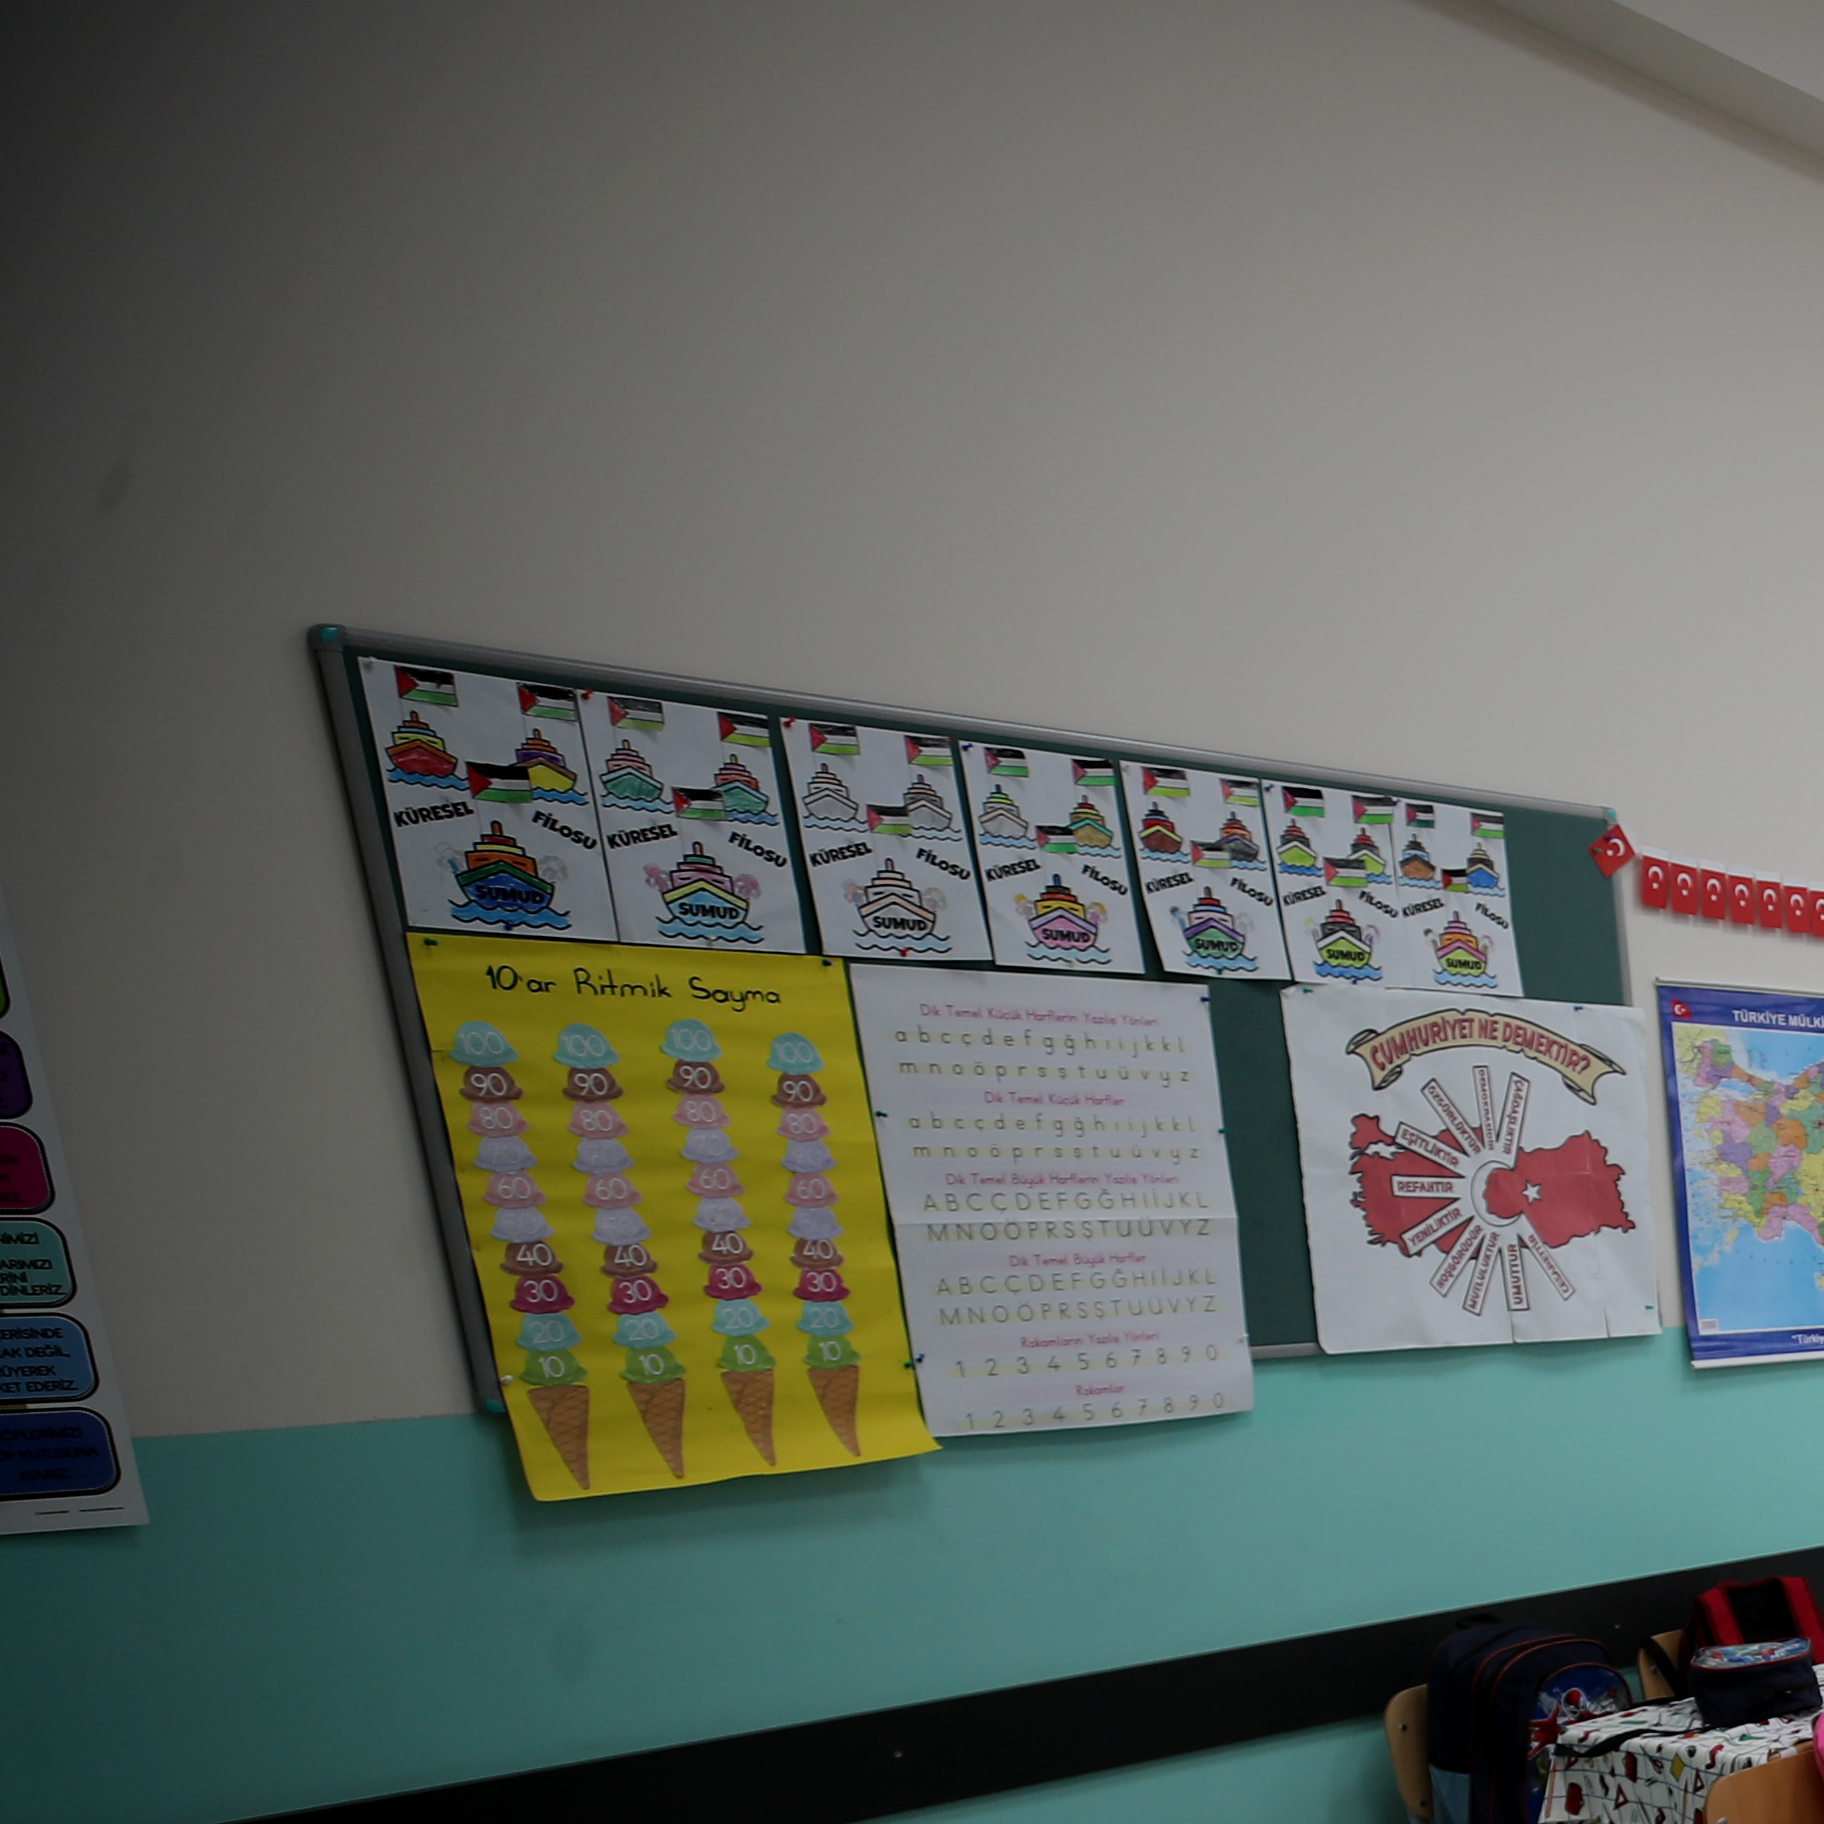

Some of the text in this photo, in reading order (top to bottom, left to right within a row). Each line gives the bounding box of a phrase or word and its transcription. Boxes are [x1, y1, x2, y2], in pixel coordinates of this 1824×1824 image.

[395, 801, 474, 827] KÜRESEL
[532, 810, 597, 850] FİLOSU
[607, 824, 679, 850] KÜRESEL
[728, 831, 788, 868] FİLOSU
[810, 842, 872, 867] KÜRESEL
[916, 848, 971, 880] FİLOSU
[985, 859, 1041, 882] KÜRESEL
[1081, 864, 1128, 896] FİLOSU
[1146, 872, 1193, 894] KÜRESEL
[475, 884, 544, 903] SUMUD
[1229, 878, 1273, 906] FİLOSU
[1283, 886, 1327, 906] KÜRESEL
[679, 902, 740, 920] SUMUD
[1359, 890, 1398, 919] FİLOSU
[1402, 898, 1445, 918] KÜRESEL
[1475, 902, 1508, 929] FİLOSU
[872, 916, 925, 932] SUMUD
[1041, 928, 1090, 944] SUMUD
[1195, 939, 1239, 954] SUMUD
[1326, 950, 1365, 963] SUMUD
[1446, 959, 1482, 971] SUMUD
[573, 967, 672, 998] Ritmik
[688, 976, 782, 1012] Sayma
[1733, 1009, 1789, 1025] TÜRKİYE
[460, 1031, 504, 1054] 100
[562, 1034, 604, 1056] 100
[672, 1029, 711, 1050] 100
[1371, 1016, 1590, 1074] CUMHURİYET NE DEMEKTİR?
[775, 1042, 812, 1063] 100
[470, 1073, 507, 1096] 90
[574, 1073, 607, 1096] 90
[680, 1066, 711, 1088] 90
[783, 1081, 813, 1102] 90
[481, 1107, 513, 1129] 80
[580, 1110, 612, 1131] 80
[687, 1101, 716, 1122] 80
[788, 1113, 817, 1134] 80
[498, 1177, 530, 1199] 60
[595, 1178, 626, 1200] 60
[701, 1169, 730, 1189] 60
[798, 1179, 826, 1199] 60
[1398, 1181, 1453, 1193] REFAHTIR
[712, 1233, 743, 1254] 40
[803, 1240, 834, 1260] 40
[517, 1244, 552, 1266] 40
[614, 1244, 647, 1267] 40
[715, 1267, 746, 1289] 30
[806, 1272, 837, 1292] 30
[523, 1280, 558, 1303] 30
[618, 1280, 652, 1303] 30
[721, 1307, 753, 1328] 20
[809, 1308, 839, 1328] 20
[529, 1320, 565, 1344] 20
[625, 1319, 659, 1340] 20
[733, 1344, 756, 1365] 10
[819, 1341, 841, 1361] 10
[539, 1356, 565, 1378] 10
[637, 1353, 664, 1375] 10
